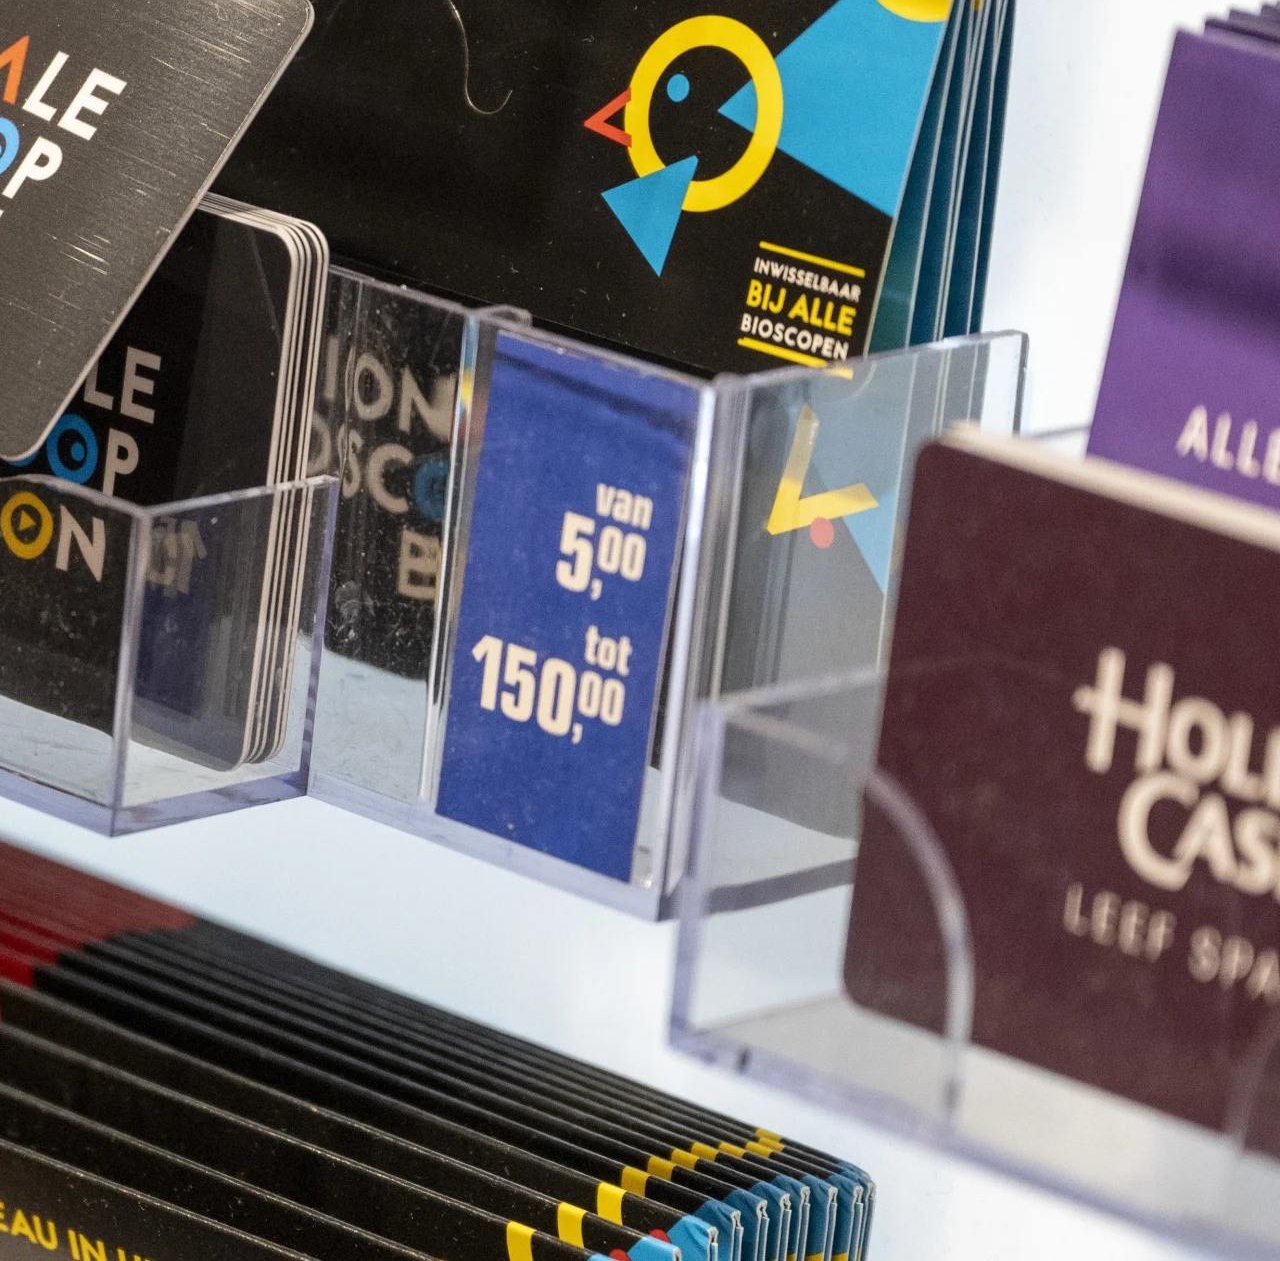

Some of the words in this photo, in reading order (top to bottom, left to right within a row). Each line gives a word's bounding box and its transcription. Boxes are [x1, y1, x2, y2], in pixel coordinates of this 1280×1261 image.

[753, 257, 862, 303] INWISSELBAAR
[746, 279, 787, 314] BIJ
[787, 293, 857, 337] ALLE
[740, 312, 849, 362] BIOSCOPEN
[596, 482, 654, 530] van
[556, 510, 647, 601] 5,00
[585, 624, 633, 677] tot
[471, 634, 626, 745] 150,00
[1064, 882, 1178, 963] LEEF
